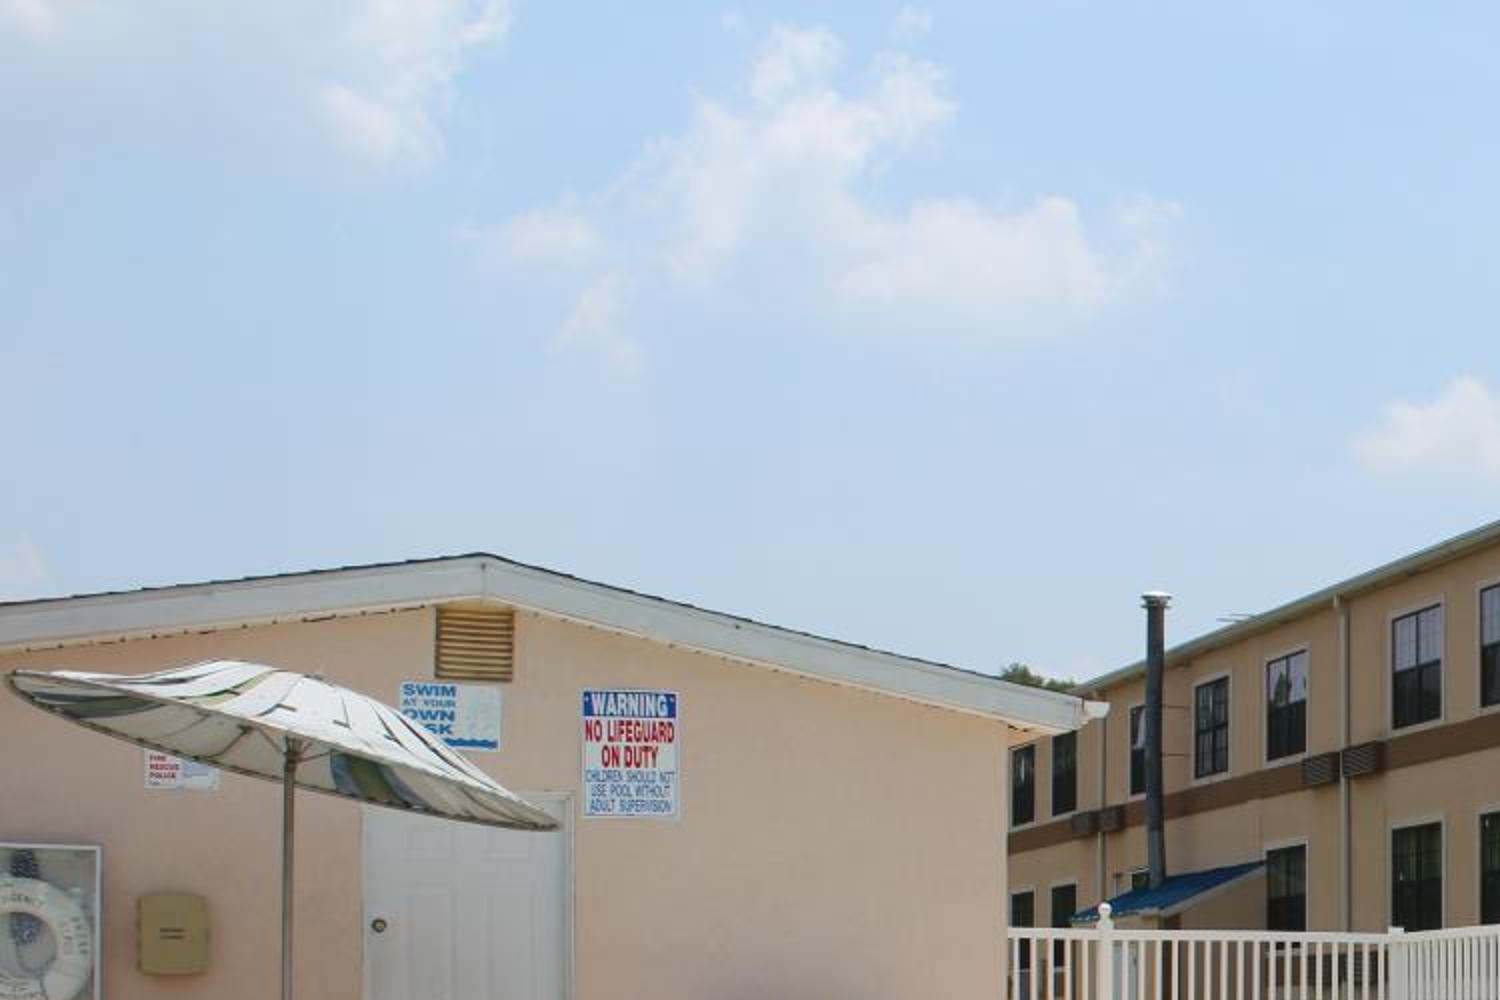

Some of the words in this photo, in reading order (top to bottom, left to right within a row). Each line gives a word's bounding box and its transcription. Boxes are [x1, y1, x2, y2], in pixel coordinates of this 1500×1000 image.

[403, 683, 456, 698] SWIM
[423, 699, 455, 707] YOUR
[591, 693, 669, 717] WARNING
[403, 708, 455, 721] OWN
[585, 719, 603, 742] NO
[607, 719, 674, 743] LIFEGUARD
[602, 744, 619, 768] ON
[624, 745, 658, 768] DUTY
[585, 769, 623, 782] CHILDREN
[626, 770, 656, 783] SHOULD
[660, 770, 675, 783] NOT
[591, 783, 608, 797] USE
[610, 783, 632, 797] POOL
[636, 784, 671, 798] WITHOUT
[590, 798, 616, 812] ADULT
[619, 799, 672, 813] SUPERVISION
